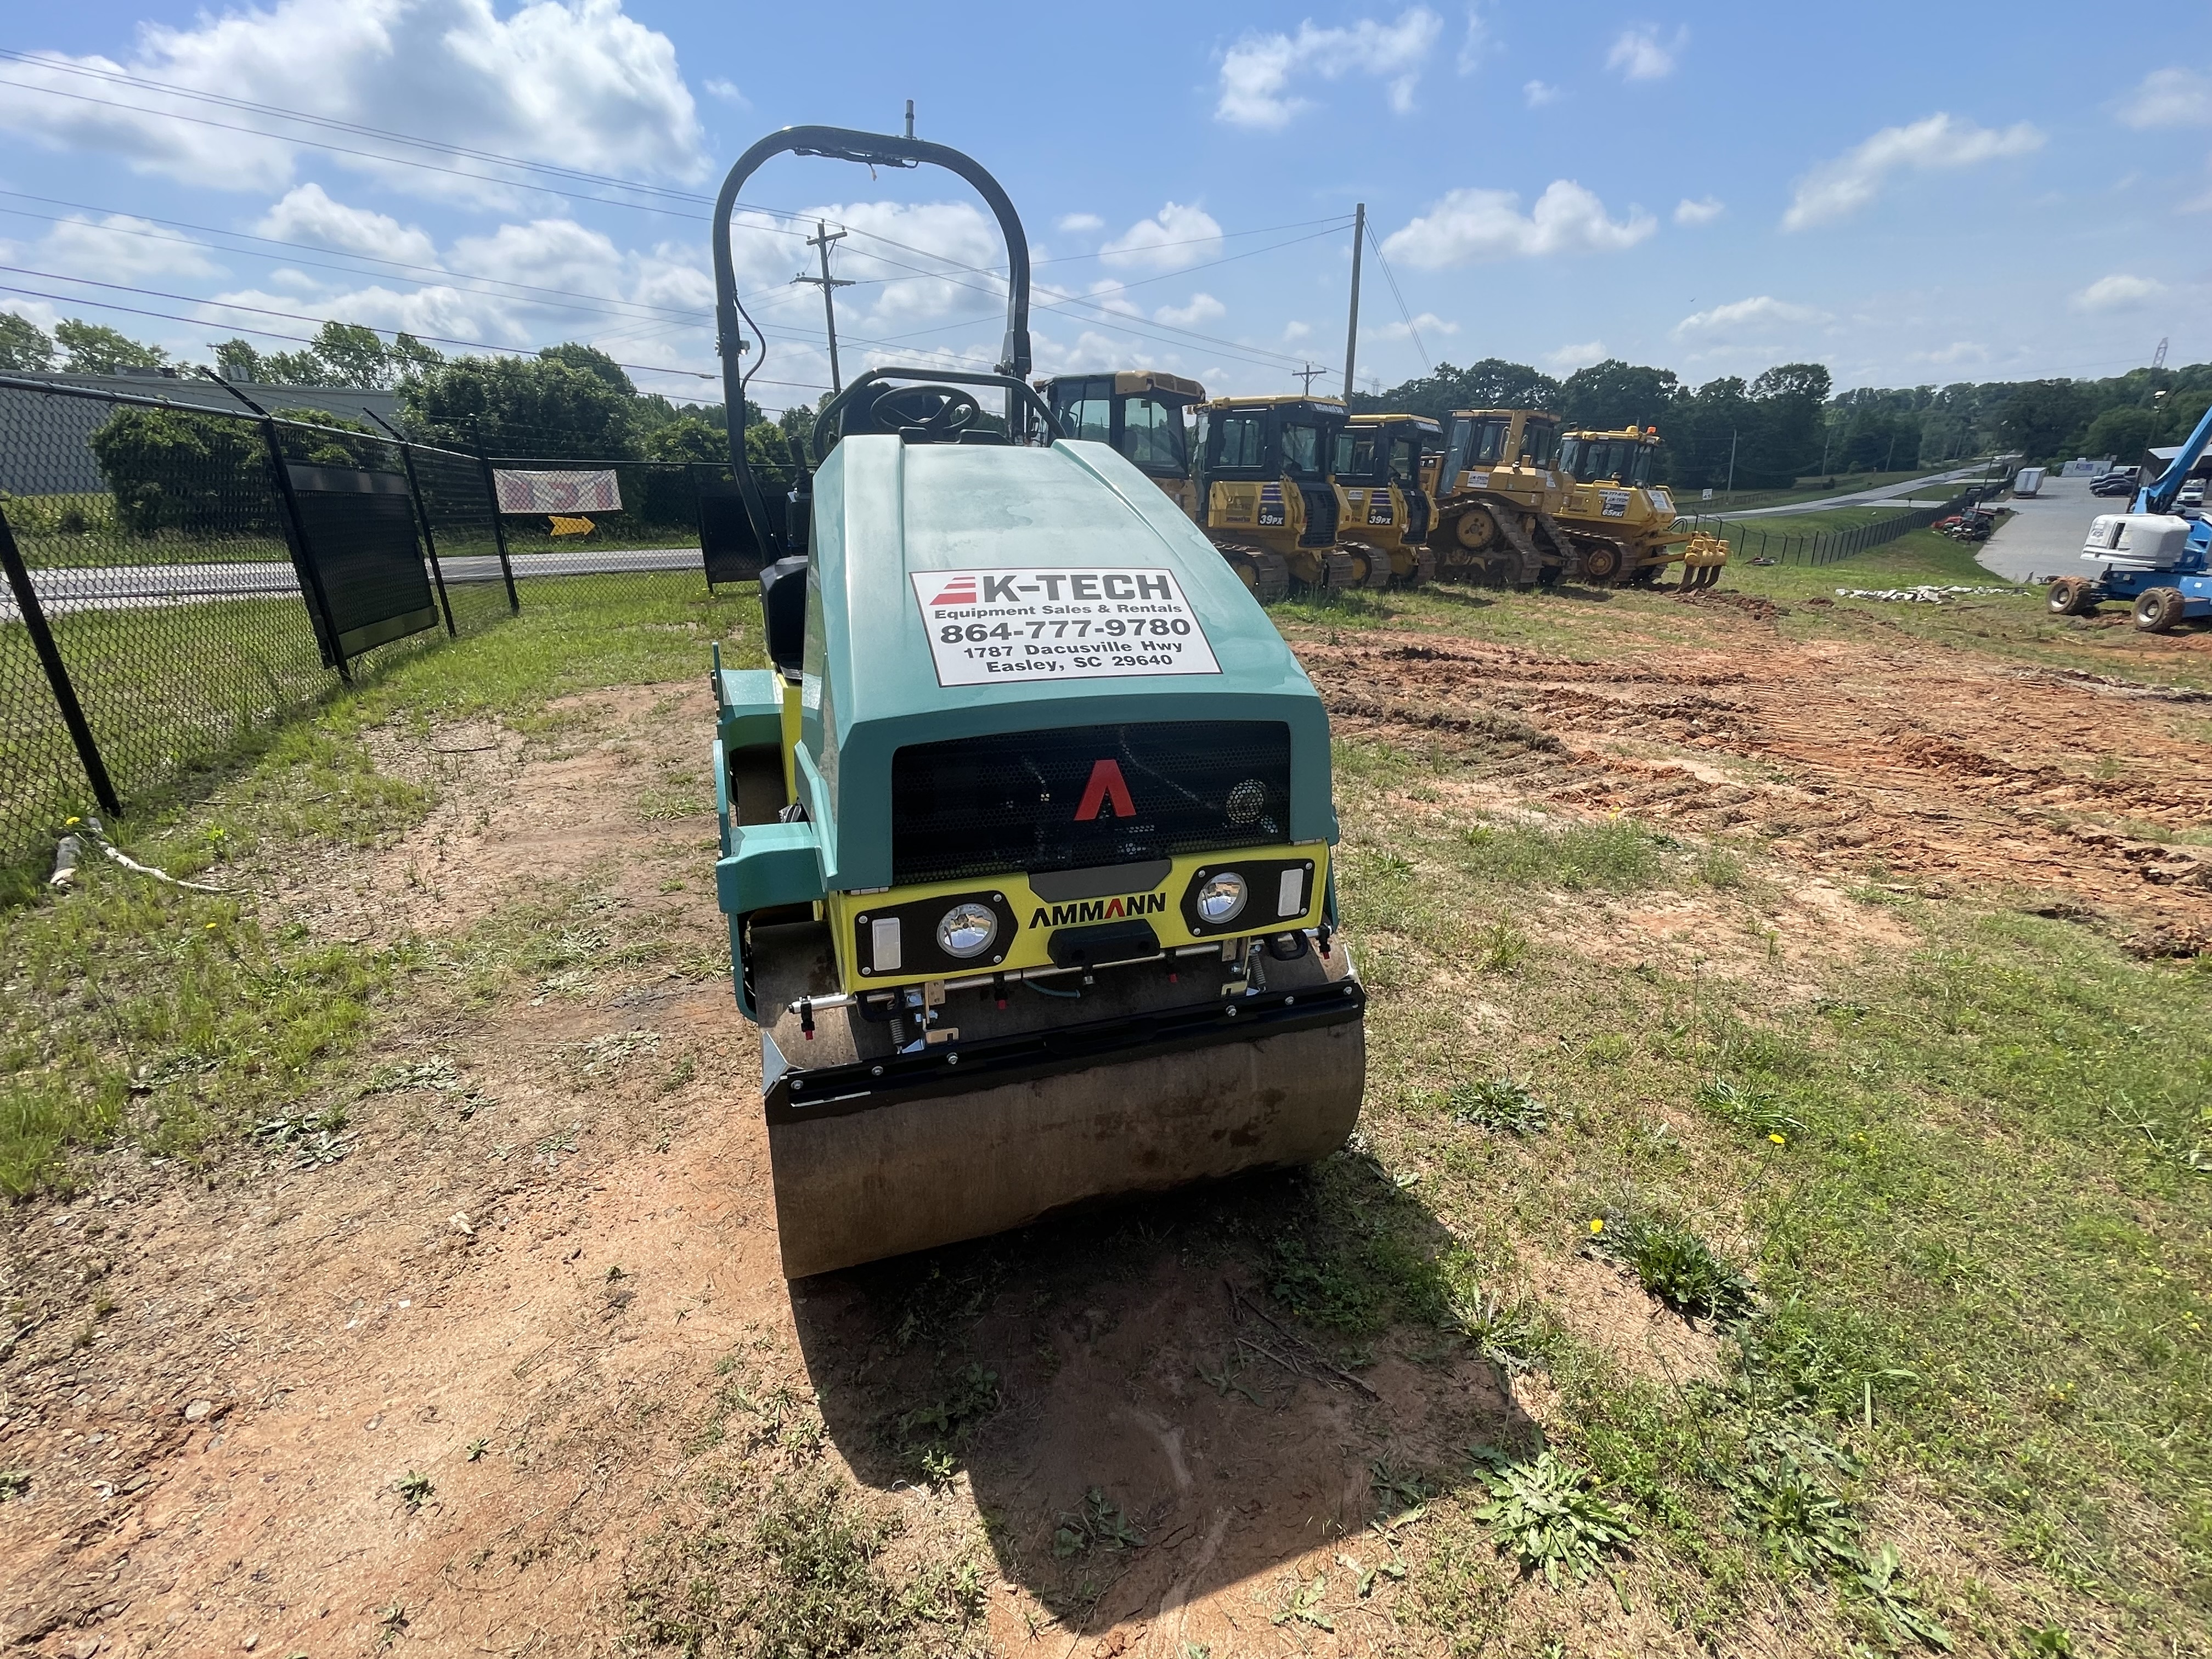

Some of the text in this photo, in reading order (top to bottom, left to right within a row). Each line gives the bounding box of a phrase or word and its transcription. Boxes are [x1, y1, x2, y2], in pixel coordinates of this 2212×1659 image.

[1260, 515, 1283, 524] 39PX
[1369, 516, 1391, 524] 39PX
[983, 574, 1172, 602] K-TECH
[934, 604, 1182, 620] Equipment Sales & Rentals
[940, 618, 1191, 644] 864-777-9780
[963, 641, 1182, 658] 1787 Dacusville Hwy
[986, 654, 1173, 673] Easley, SC 29640
[1028, 892, 1166, 929] AMMANN
